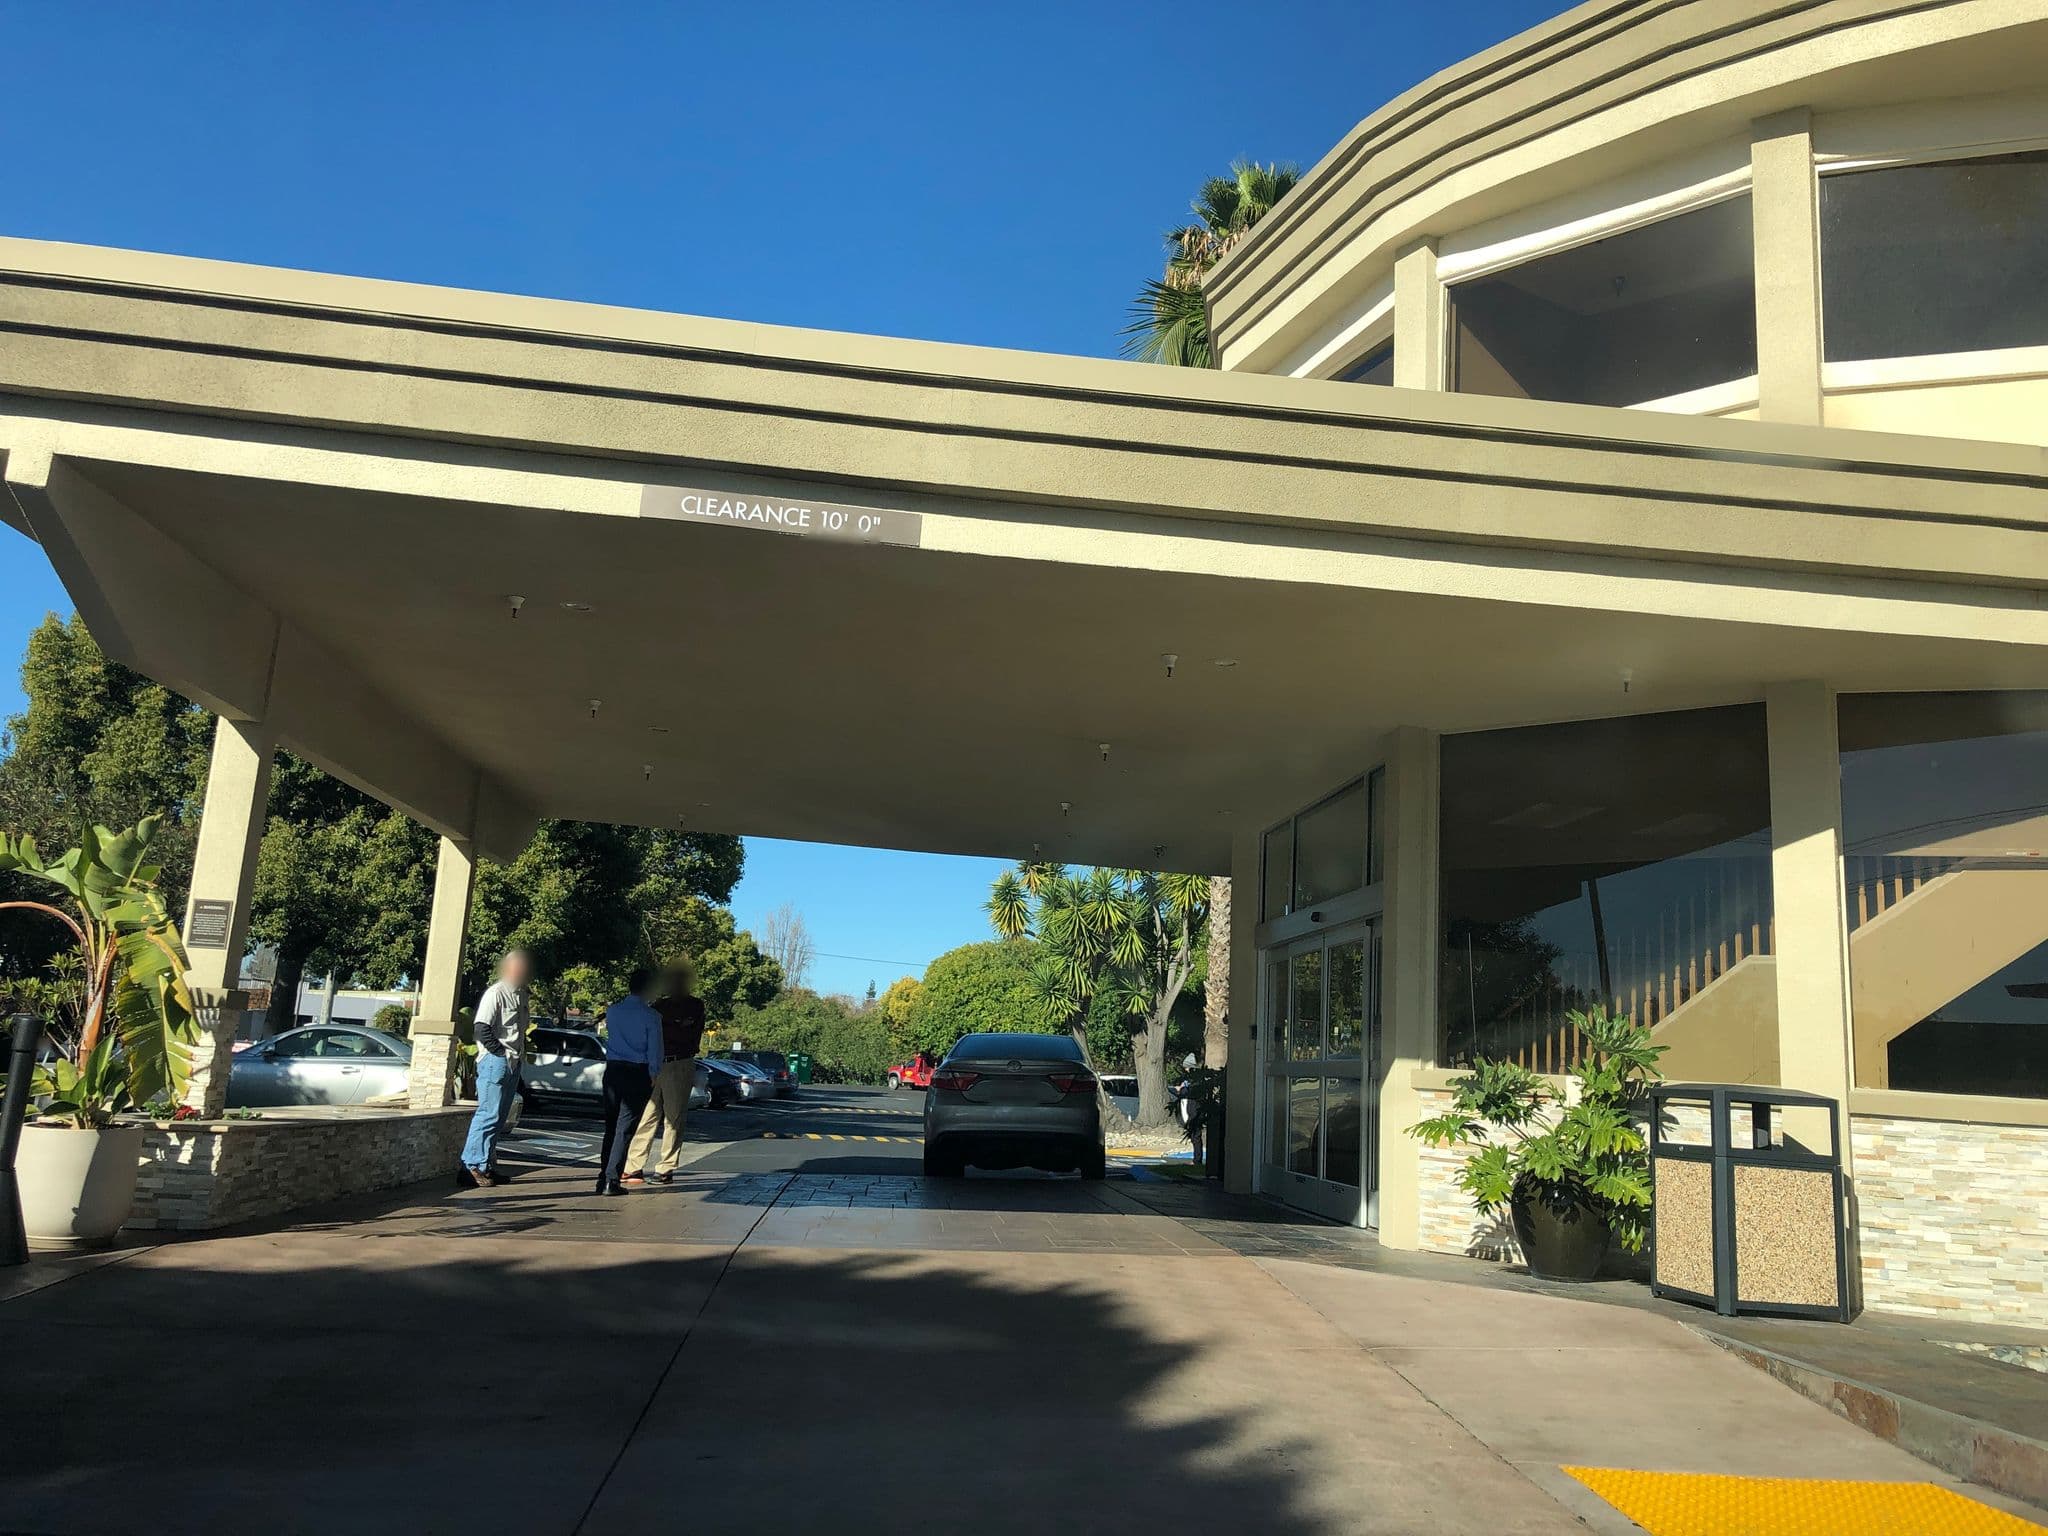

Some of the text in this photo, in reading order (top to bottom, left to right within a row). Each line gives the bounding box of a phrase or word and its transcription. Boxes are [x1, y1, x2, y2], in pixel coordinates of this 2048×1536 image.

[681, 496, 881, 533] CLEARANCE 10' 0"
